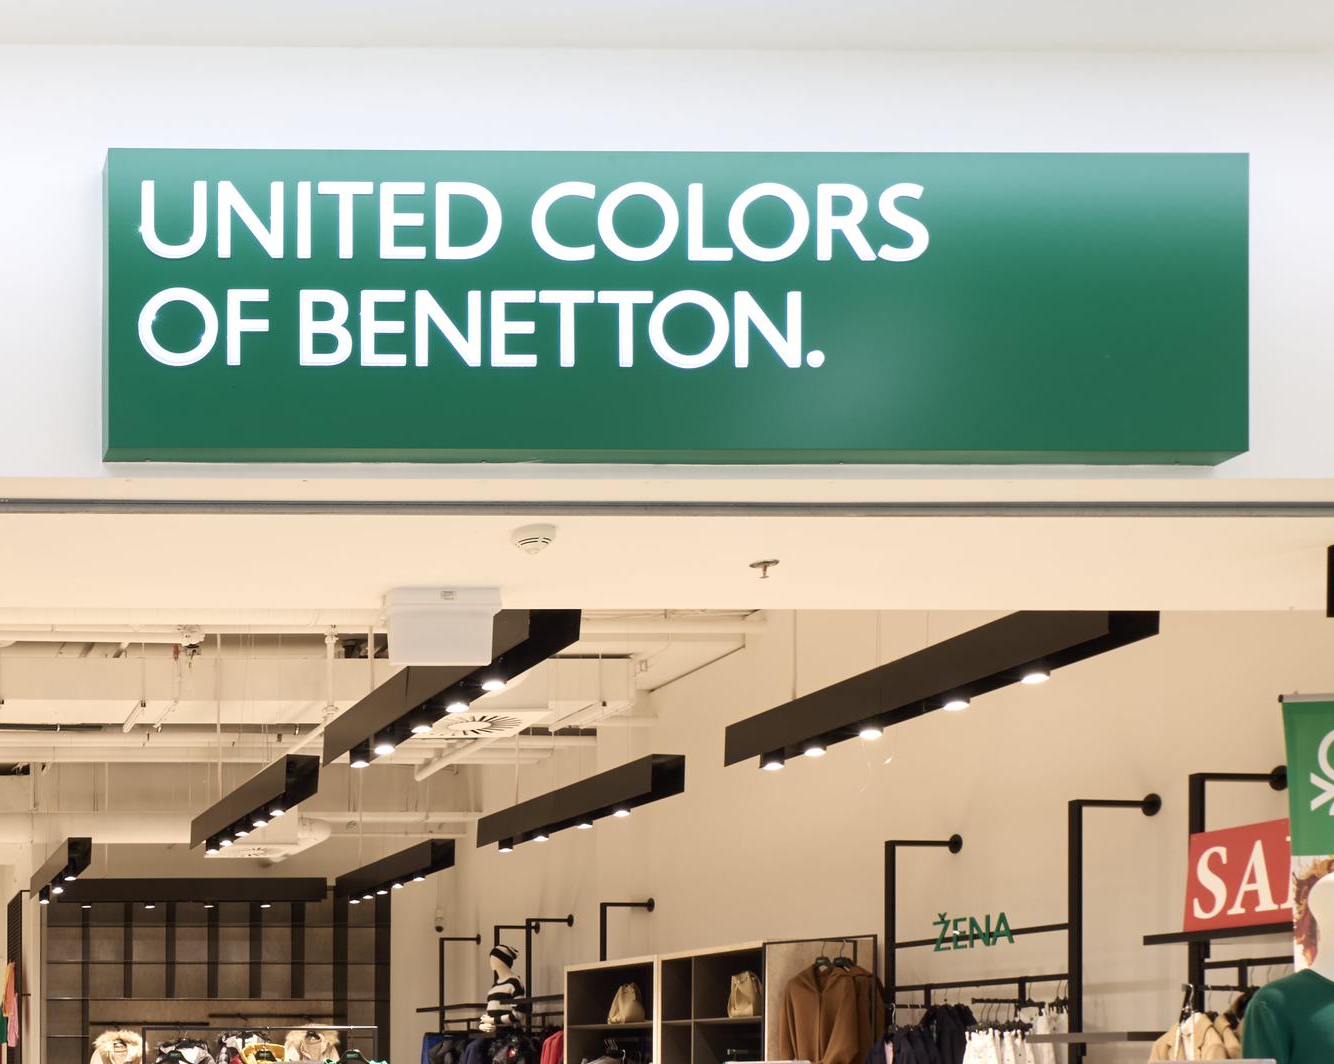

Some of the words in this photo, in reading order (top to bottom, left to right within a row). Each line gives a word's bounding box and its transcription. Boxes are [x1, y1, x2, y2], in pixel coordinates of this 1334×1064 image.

[139, 180, 502, 260] UNITED
[531, 181, 930, 263] COLORS
[137, 286, 269, 367] OF
[299, 289, 826, 370] BENETTON.
[932, 912, 1015, 952] ŽENA
